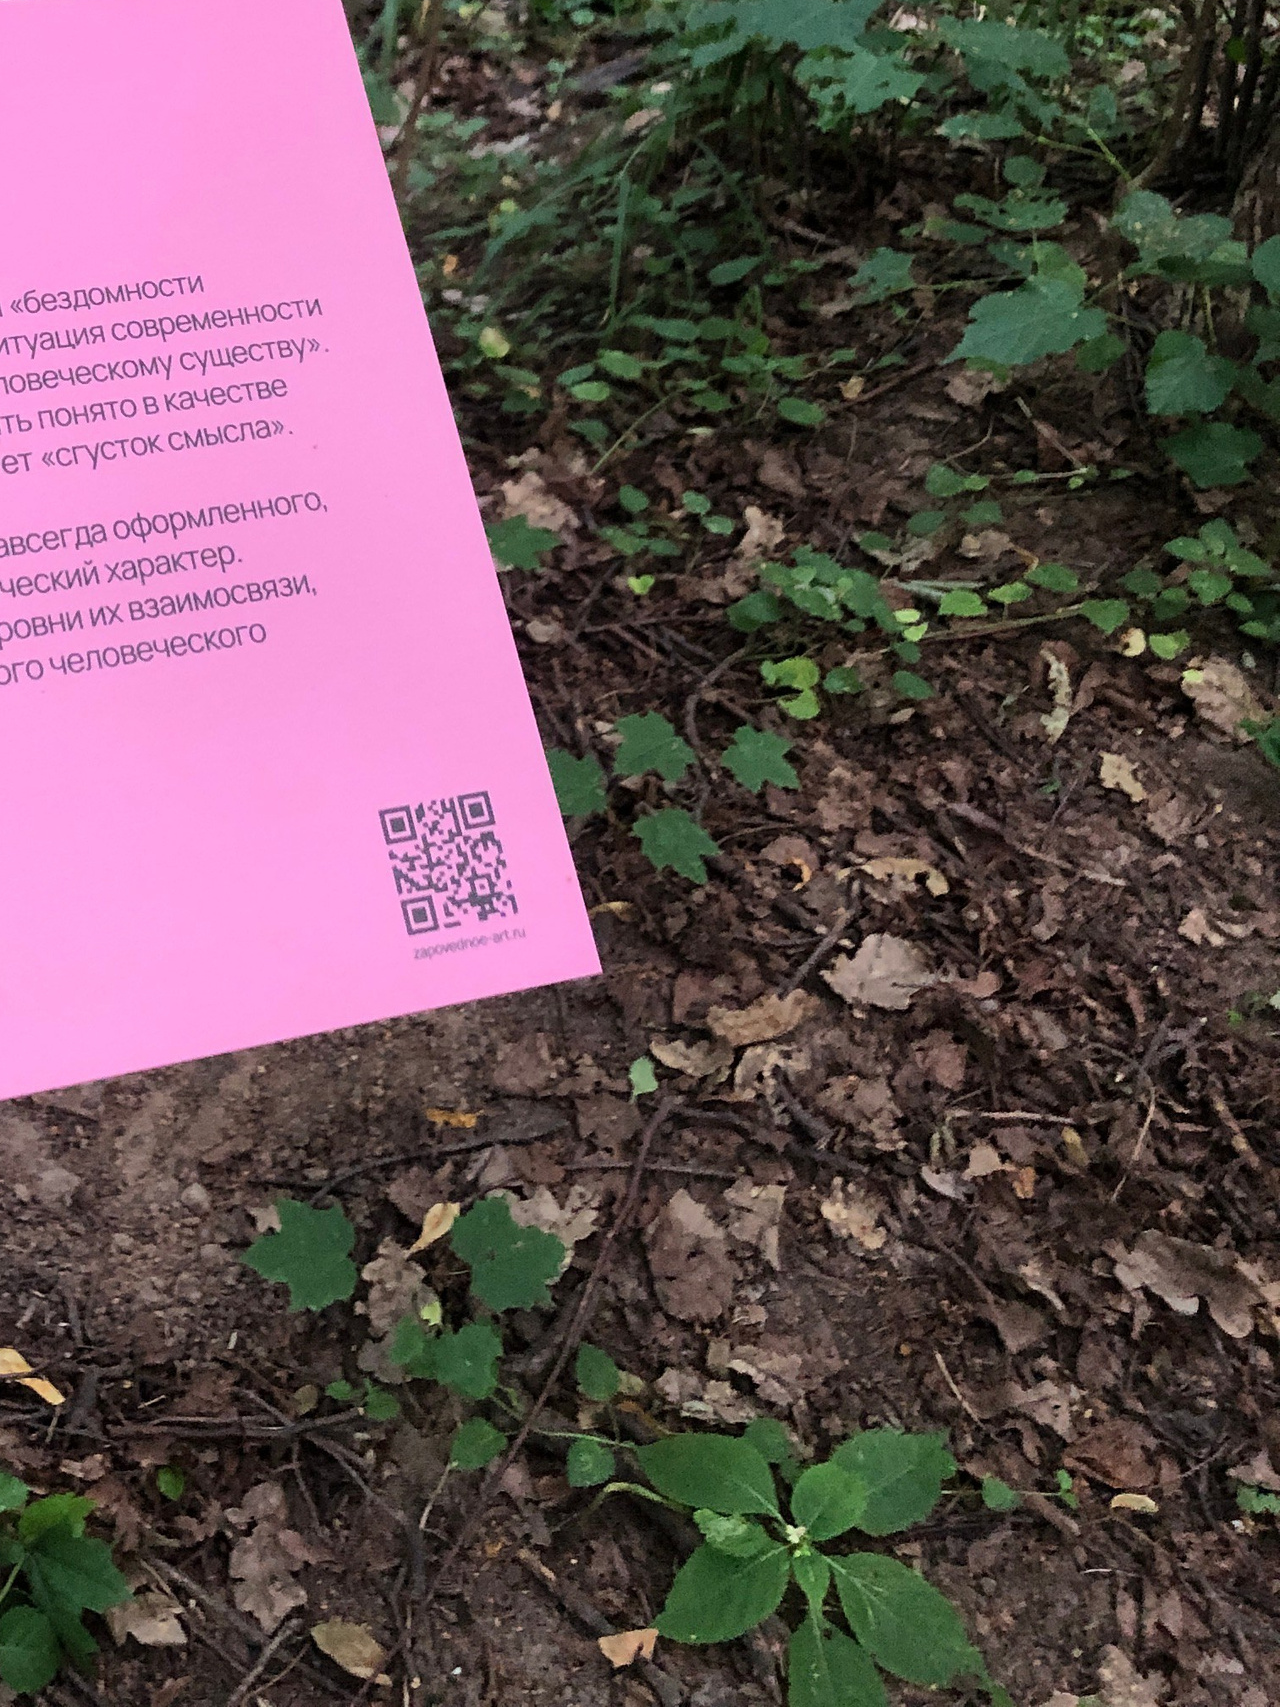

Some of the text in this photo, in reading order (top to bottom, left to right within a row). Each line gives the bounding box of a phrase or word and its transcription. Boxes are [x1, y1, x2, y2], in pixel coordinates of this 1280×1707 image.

[9, 274, 206, 315] «бездомности
[109, 297, 324, 344] современности
[178, 336, 330, 378] существу».
[36, 397, 139, 431] понято
[141, 394, 161, 417] в
[162, 377, 290, 414] качестве
[40, 433, 166, 472] «сгусток
[166, 418, 294, 452] смысла».
[111, 490, 329, 545] оформленного,
[103, 544, 244, 587] характер.
[87, 602, 125, 629] их
[126, 573, 318, 622] взаимосвязи,
[47, 622, 268, 676] человеческого
[413, 928, 526, 960] zapovednoe-art.ru
